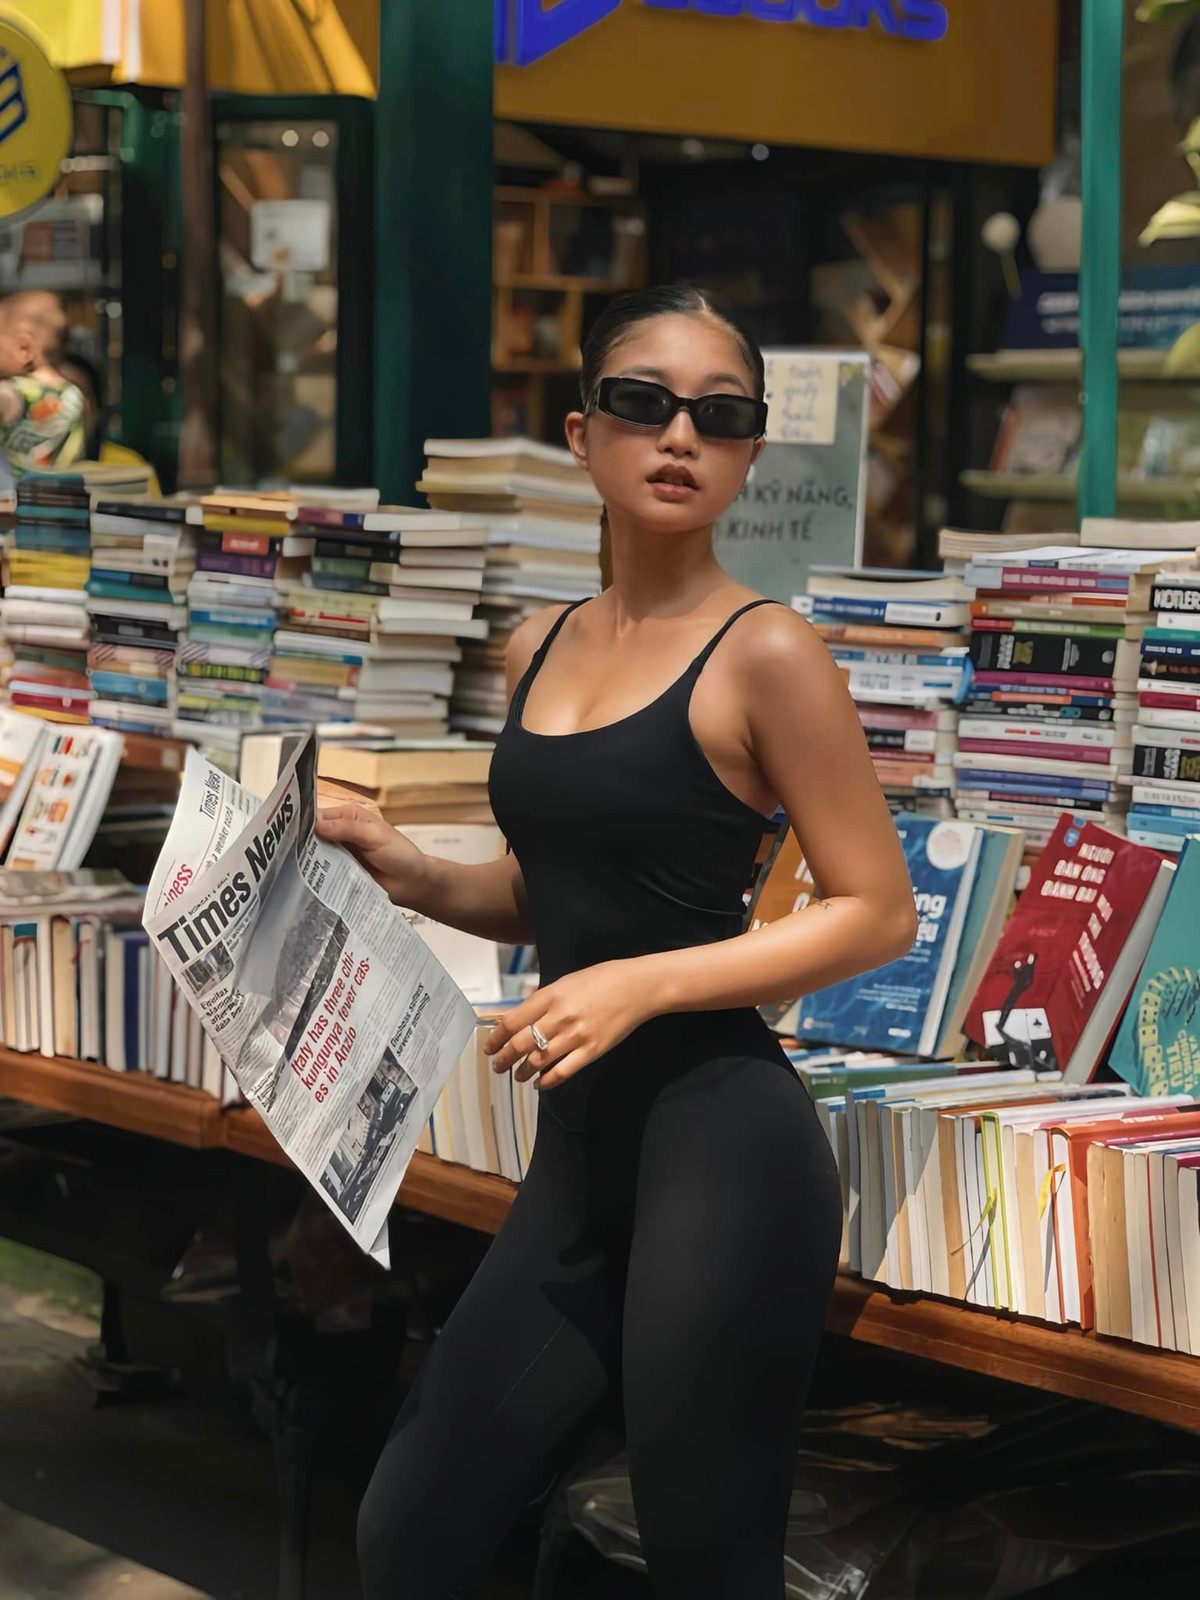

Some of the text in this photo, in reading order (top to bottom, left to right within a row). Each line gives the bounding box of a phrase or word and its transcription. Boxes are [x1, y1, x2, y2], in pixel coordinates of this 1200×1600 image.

[726, 518, 784, 541] KINH
[157, 871, 251, 964] Times
[244, 792, 294, 885] News
[163, 863, 194, 907] iness
[913, 887, 947, 919] ng
[291, 1041, 314, 1077] Italy
[307, 1014, 329, 1043] has
[324, 978, 346, 1015] three
[301, 1022, 343, 1090] kungunya
[315, 1027, 357, 1103] es in Anzio
